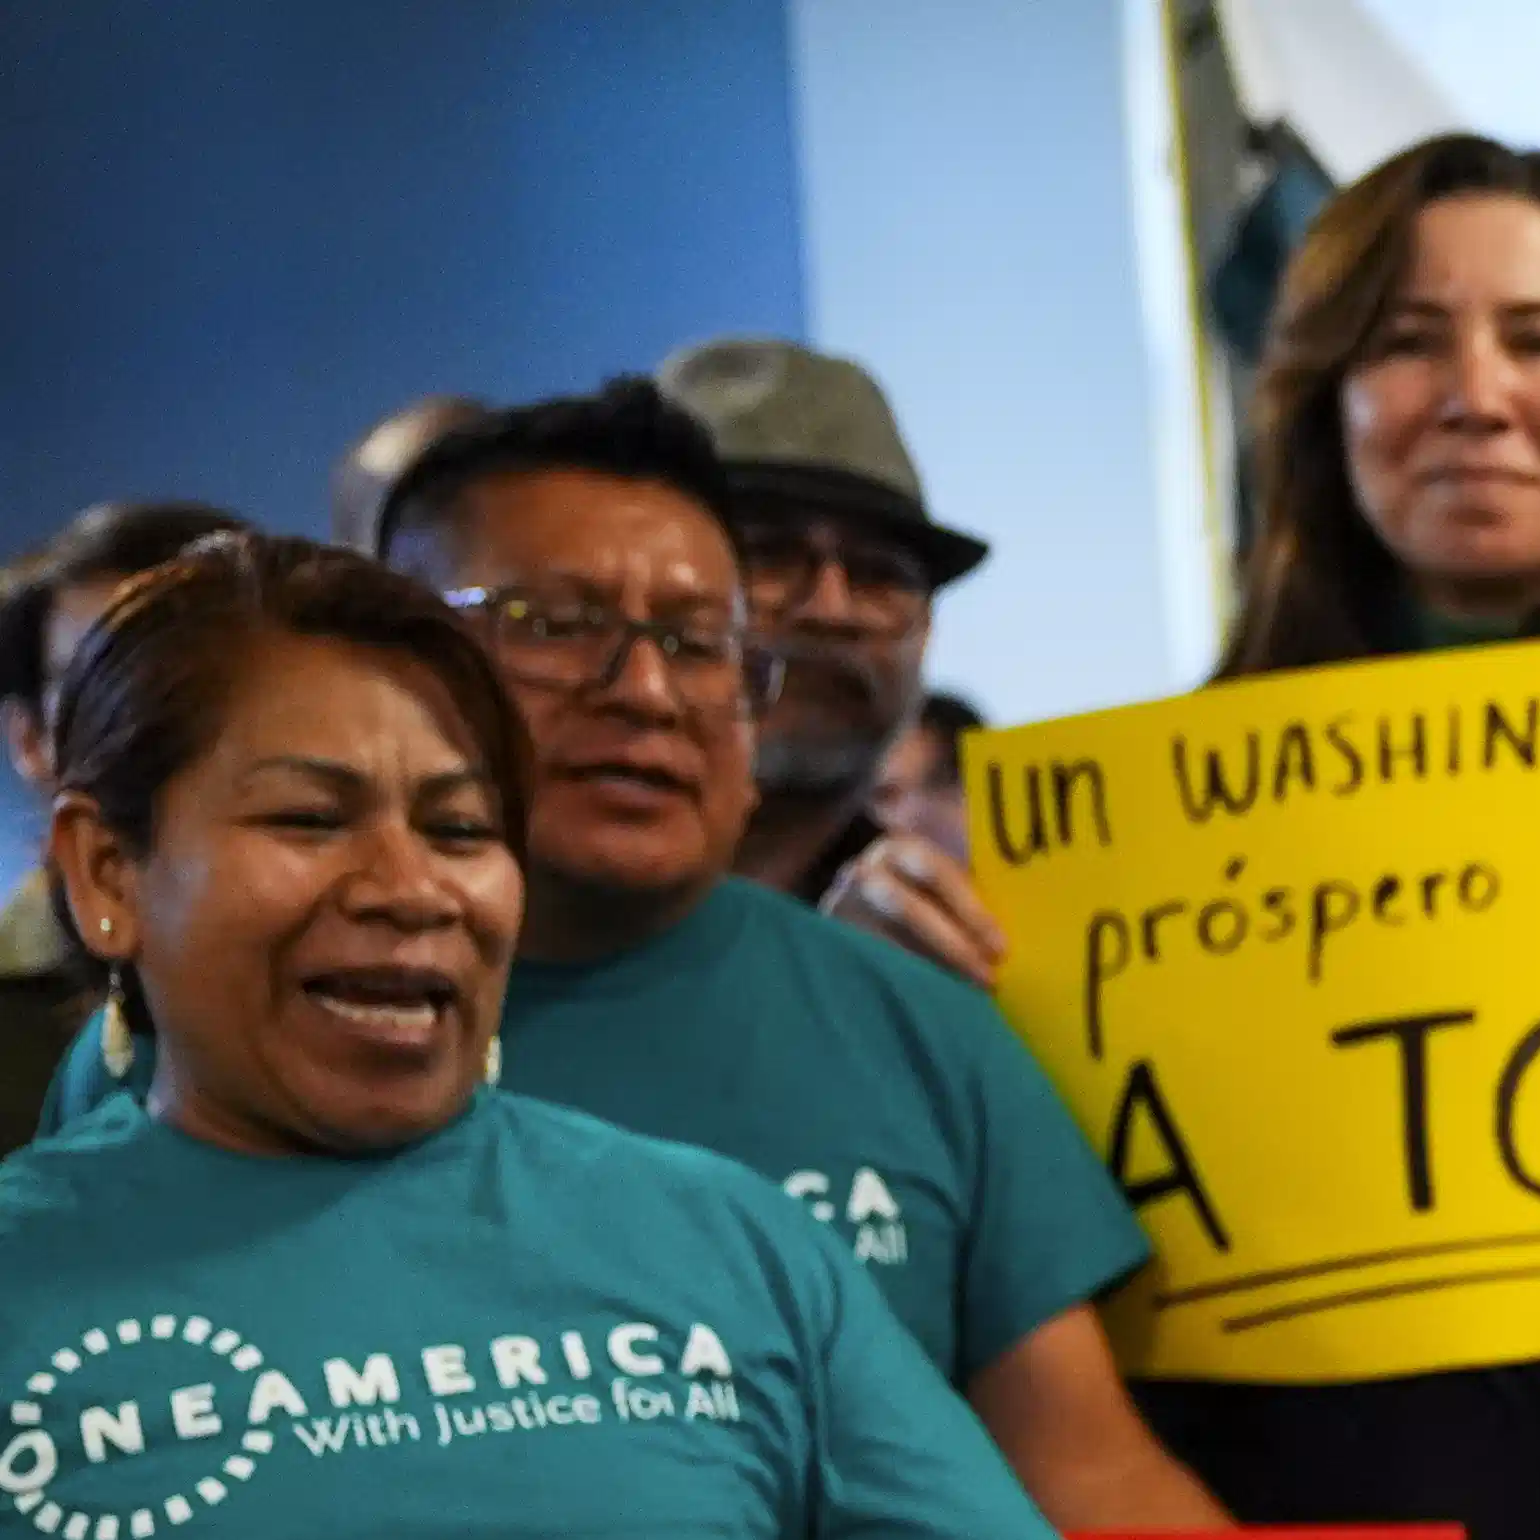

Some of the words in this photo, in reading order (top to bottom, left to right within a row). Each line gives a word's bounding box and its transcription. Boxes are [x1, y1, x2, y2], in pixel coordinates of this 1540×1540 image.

[1080, 855, 1500, 1060] próspero
[1108, 1058, 1233, 1253] A
[293, 1410, 421, 1457] With
[433, 1392, 602, 1447] Justice
[612, 1377, 674, 1423] for
[685, 1380, 741, 1424] All
